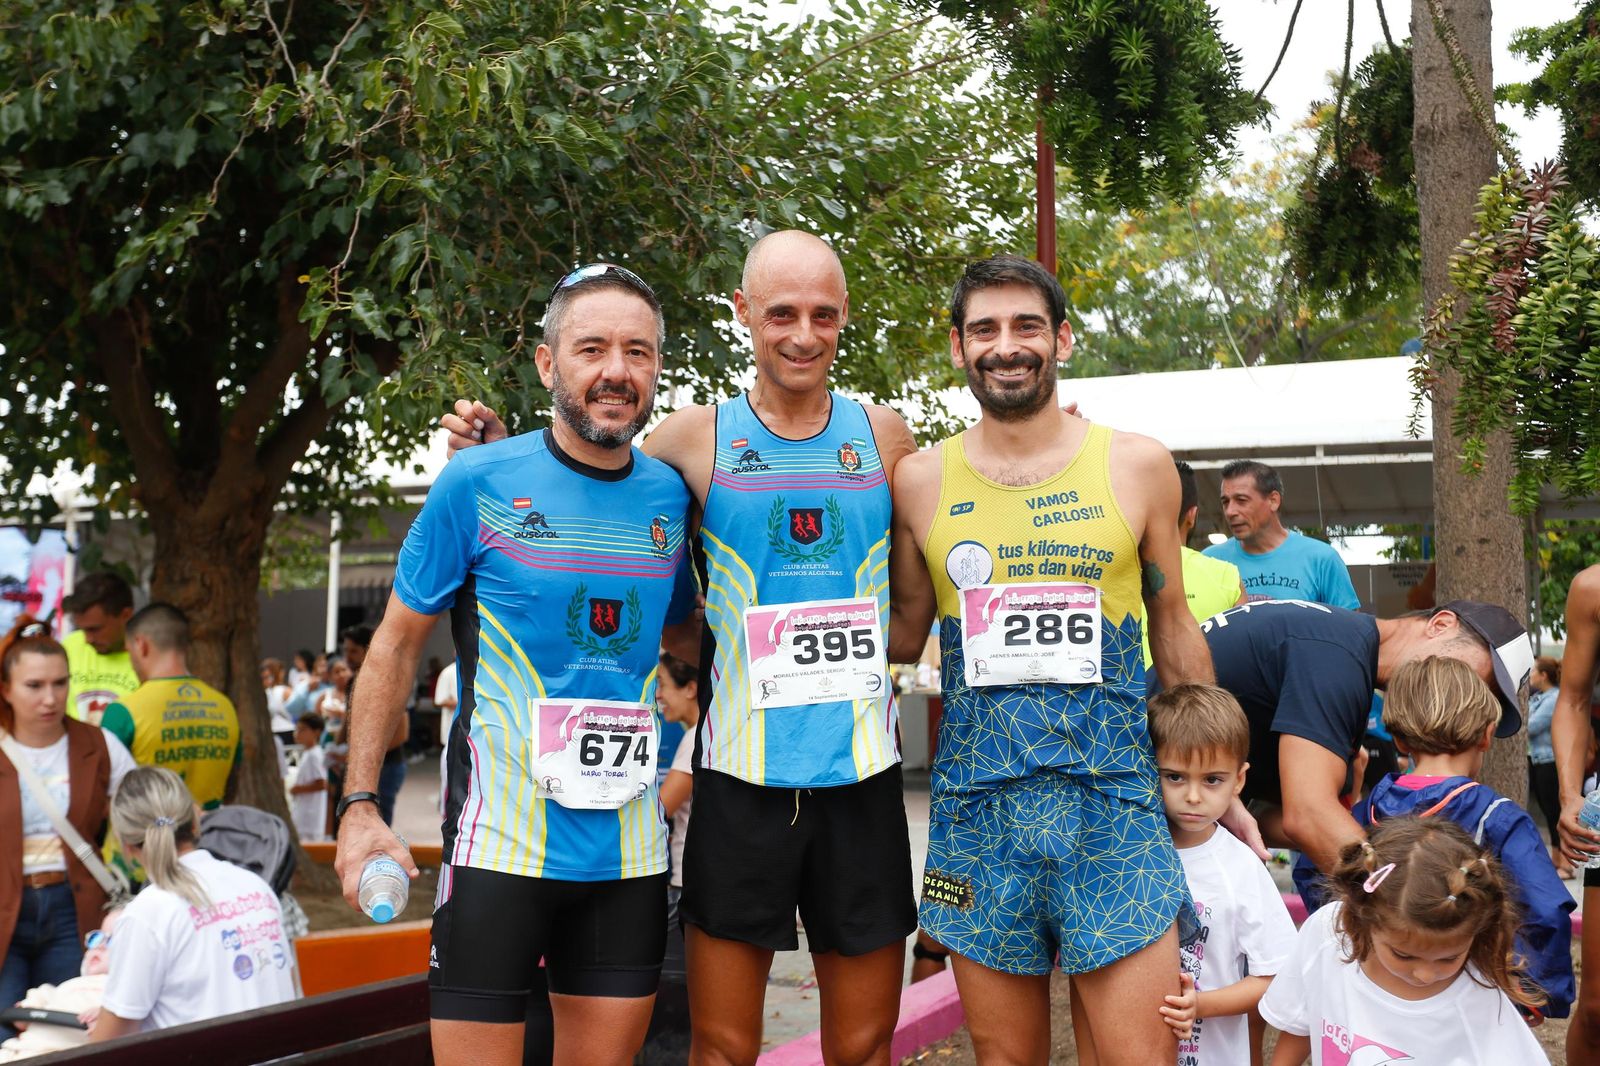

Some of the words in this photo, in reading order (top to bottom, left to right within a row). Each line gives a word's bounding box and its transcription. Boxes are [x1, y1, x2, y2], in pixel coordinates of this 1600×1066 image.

[732, 464, 772, 475] austral
[1025, 491, 1079, 510] VAMOS
[1033, 505, 1105, 527] CARLOS!!!
[513, 531, 560, 539] austral
[997, 543, 1023, 559] tus
[1028, 540, 1114, 563] kilómetros
[1008, 563, 1034, 577] nos
[1038, 558, 1066, 576] dan
[1071, 561, 1103, 580] vida
[1243, 572, 1300, 590] entina
[1004, 613, 1094, 646] 286
[793, 629, 875, 665] 395
[161, 725, 229, 743] RUNNERS
[155, 742, 231, 764] BARREÑOS
[580, 733, 650, 767] 674
[924, 876, 965, 895] DEPORTE
[927, 889, 960, 905] MANIA
